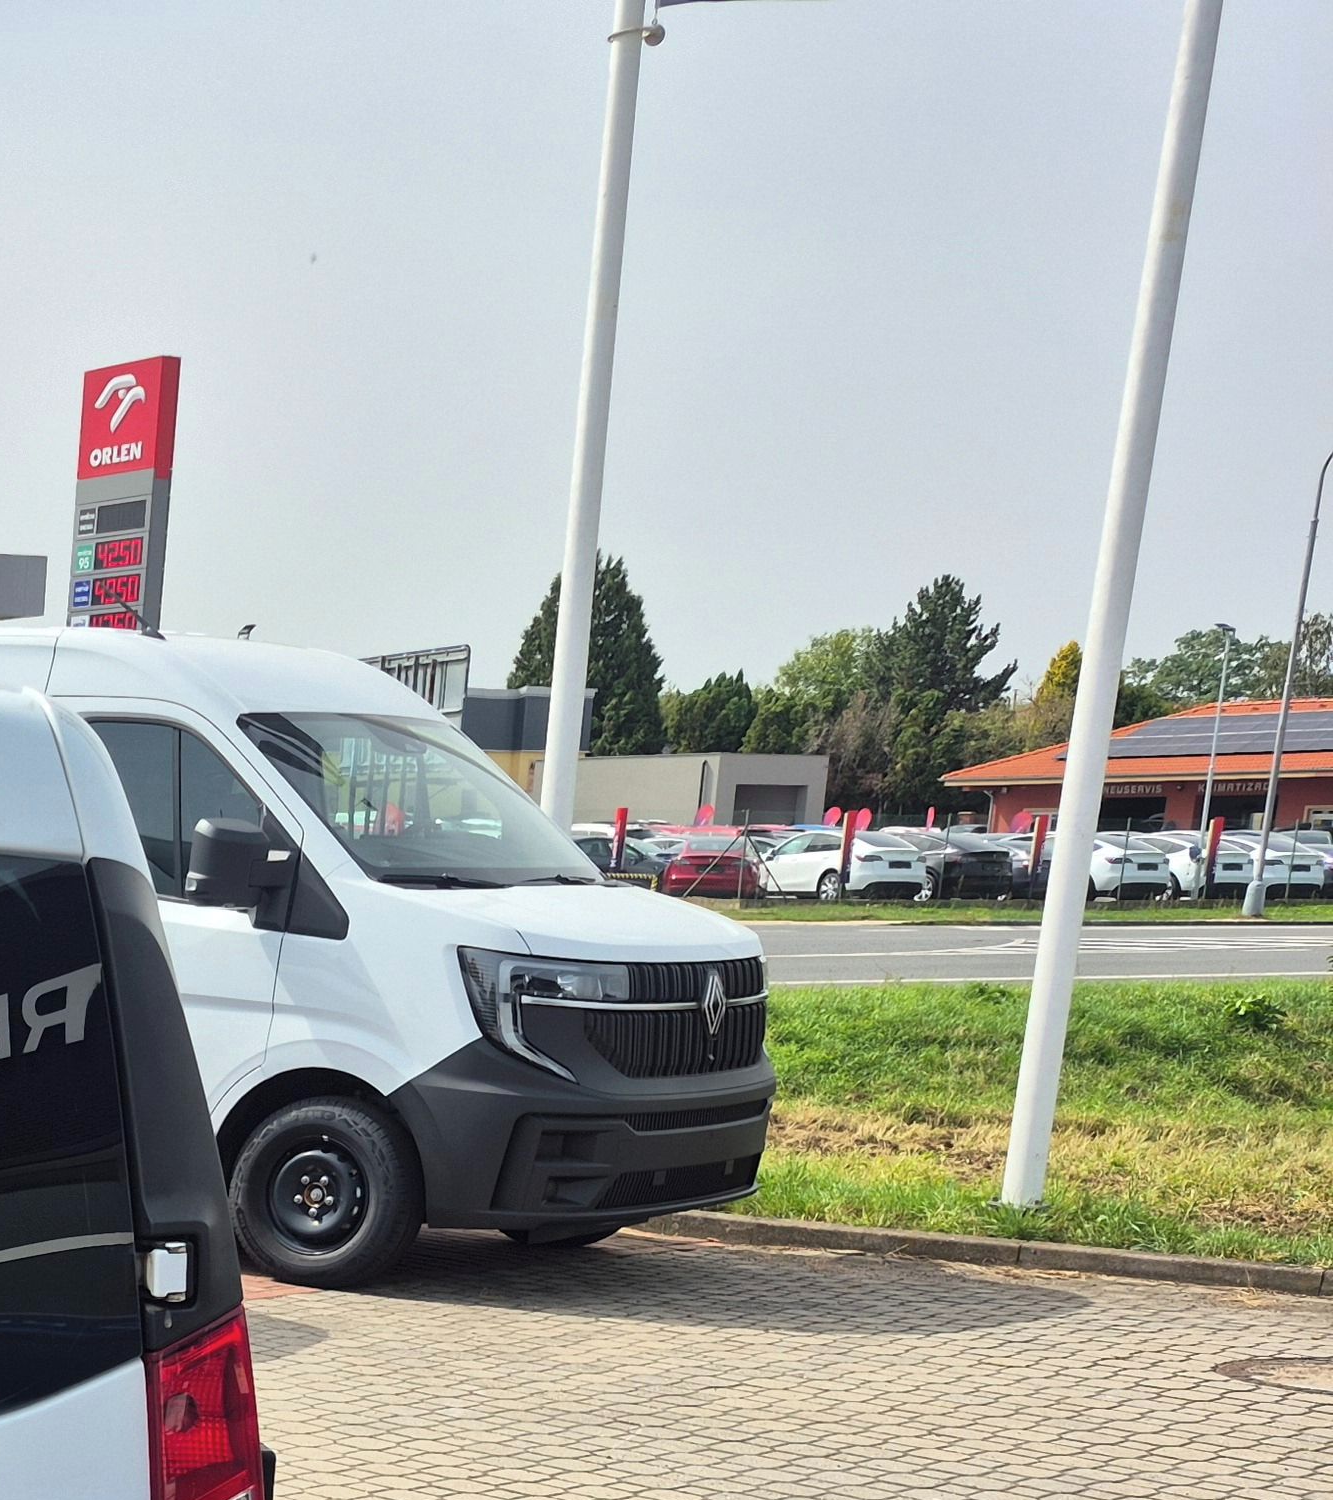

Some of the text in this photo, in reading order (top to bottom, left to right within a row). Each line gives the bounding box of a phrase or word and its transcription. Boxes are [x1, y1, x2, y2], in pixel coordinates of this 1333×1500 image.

[89, 440, 143, 468] ORLEN
[78, 557, 90, 569] 95
[1103, 784, 1163, 795] NEUSERVIS
[1197, 782, 1269, 792] KIMATIZAC
